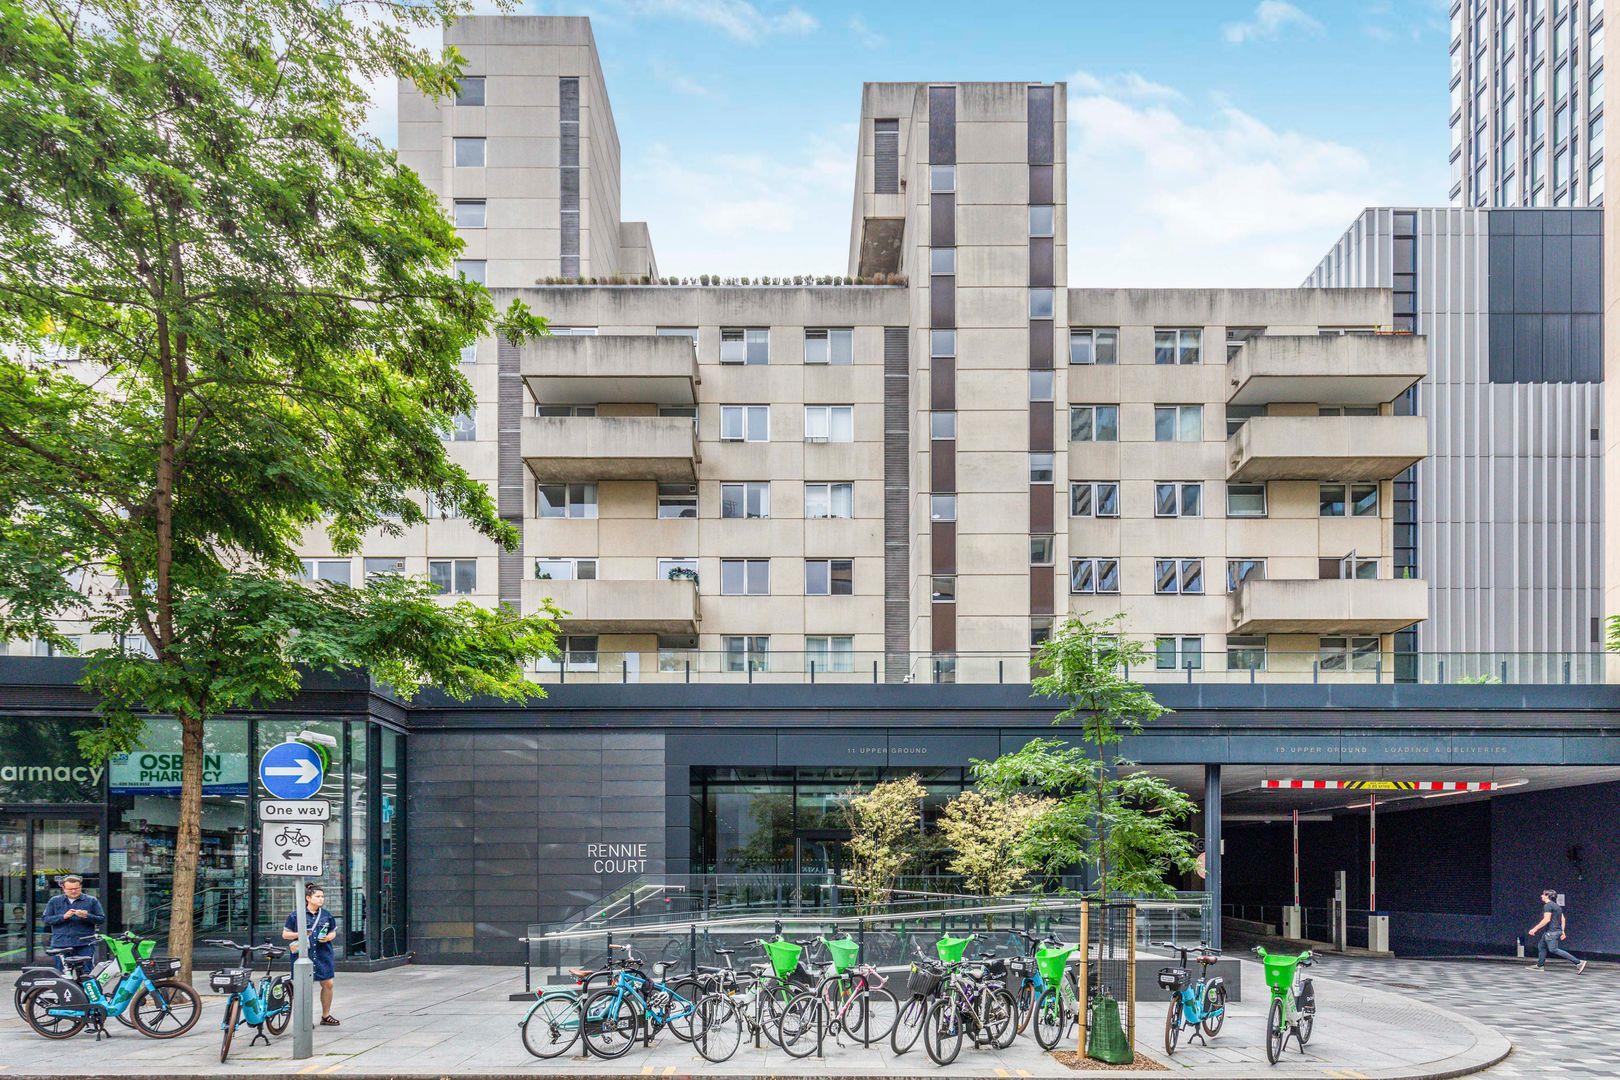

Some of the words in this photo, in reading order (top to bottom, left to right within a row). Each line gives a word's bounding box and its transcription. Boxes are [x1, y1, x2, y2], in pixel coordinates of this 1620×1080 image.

[139, 753, 221, 771] OSBN
[0, 765, 105, 787] armacy
[140, 770, 223, 782] PHARCY
[265, 805, 293, 815] One
[297, 807, 324, 817] way
[587, 843, 647, 857] RENNIE
[266, 861, 293, 871] Cycle
[296, 863, 319, 872] lane
[594, 860, 647, 873] COURT
